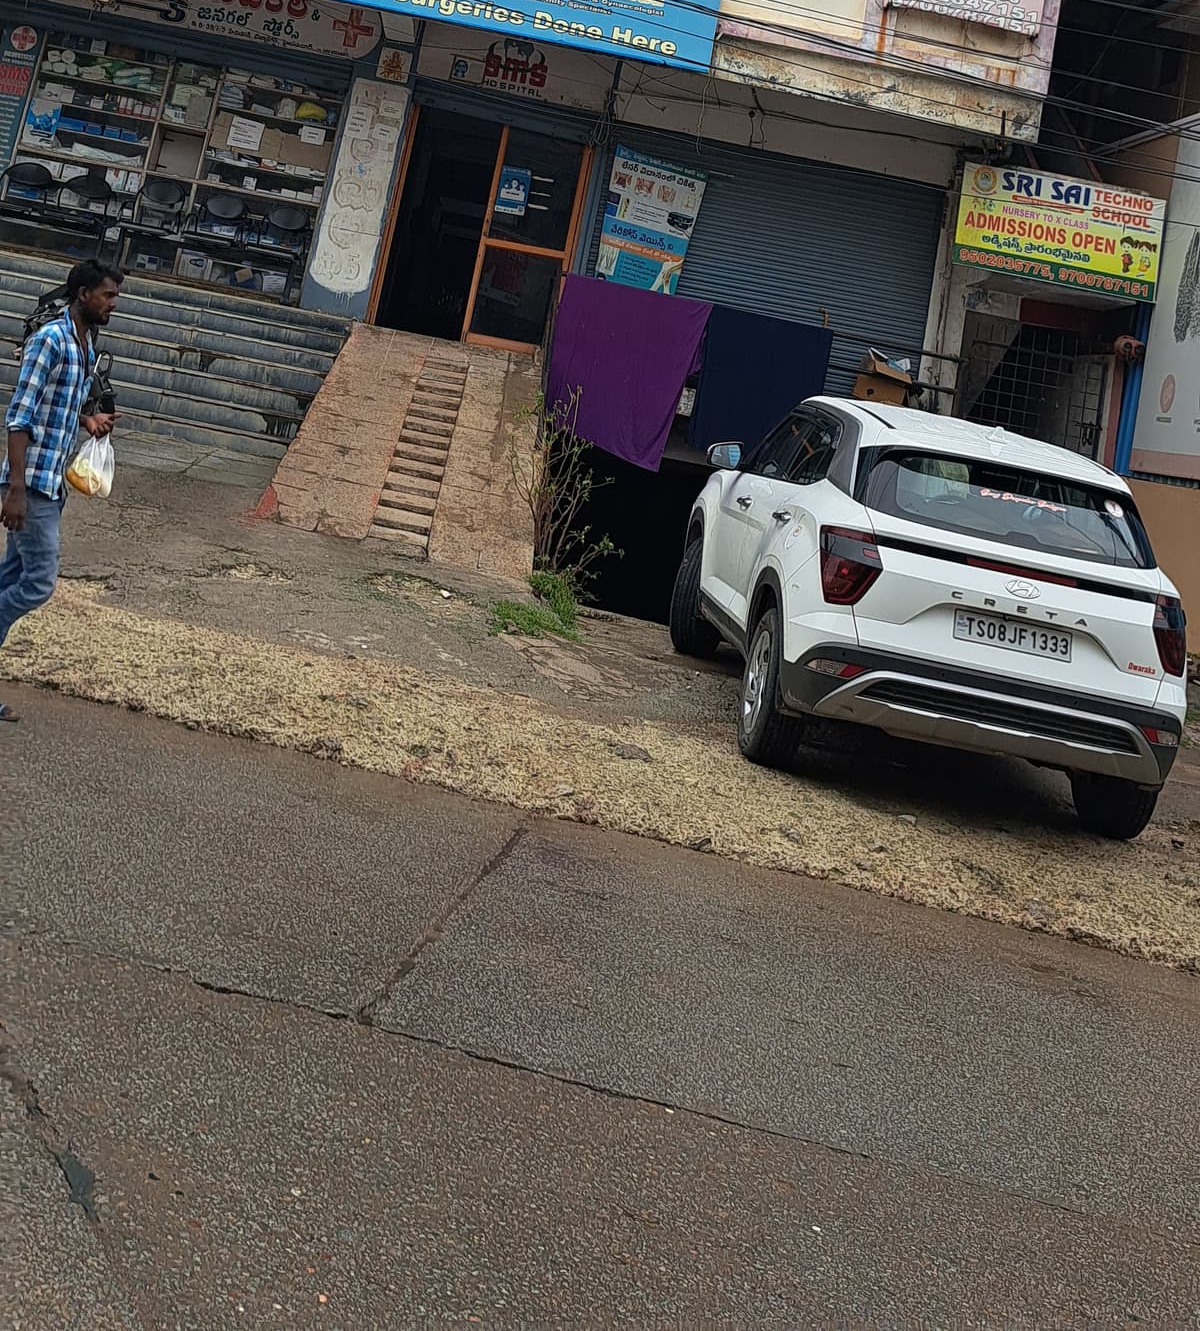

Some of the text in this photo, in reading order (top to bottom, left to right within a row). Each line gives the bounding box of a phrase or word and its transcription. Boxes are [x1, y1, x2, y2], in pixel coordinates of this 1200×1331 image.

[311, 8, 321, 23] &
[532, 11, 603, 42] Done
[611, 26, 678, 56] Here
[482, 79, 542, 97] HOSPITAL
[1002, 172, 1042, 197] SRI
[1051, 181, 1091, 206] SAI
[1094, 189, 1153, 212] TECHNO
[1002, 206, 1040, 221] NURSERY
[1043, 213, 1054, 223] TO
[1055, 215, 1062, 225] X
[1063, 217, 1089, 230] CLASS
[1092, 205, 1151, 228] SCHOOL
[965, 211, 1066, 245] ADMISSIONS
[1071, 231, 1116, 255] OPEN
[1058, 268, 1148, 297] 9700787151
[952, 590, 1088, 626] CRETA
[965, 616, 1069, 656] TS08JF1333
